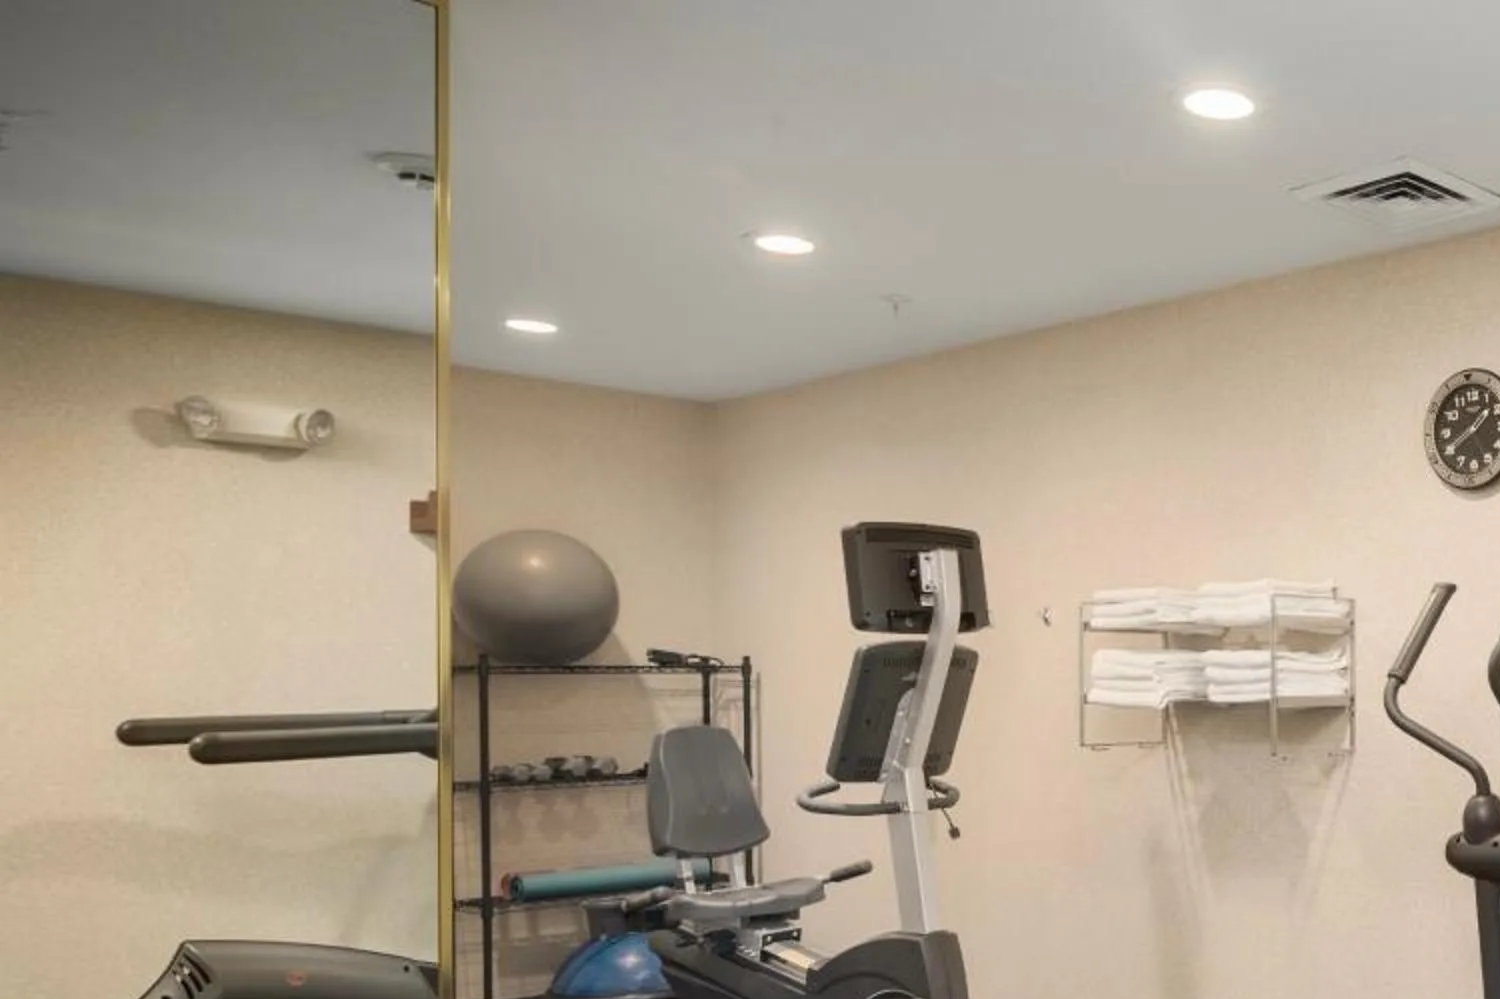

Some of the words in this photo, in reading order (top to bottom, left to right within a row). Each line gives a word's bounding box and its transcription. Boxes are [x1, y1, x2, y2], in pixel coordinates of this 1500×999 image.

[1455, 394, 1466, 407] 11
[1484, 392, 1490, 404] 1
[1443, 409, 1459, 421] 10
